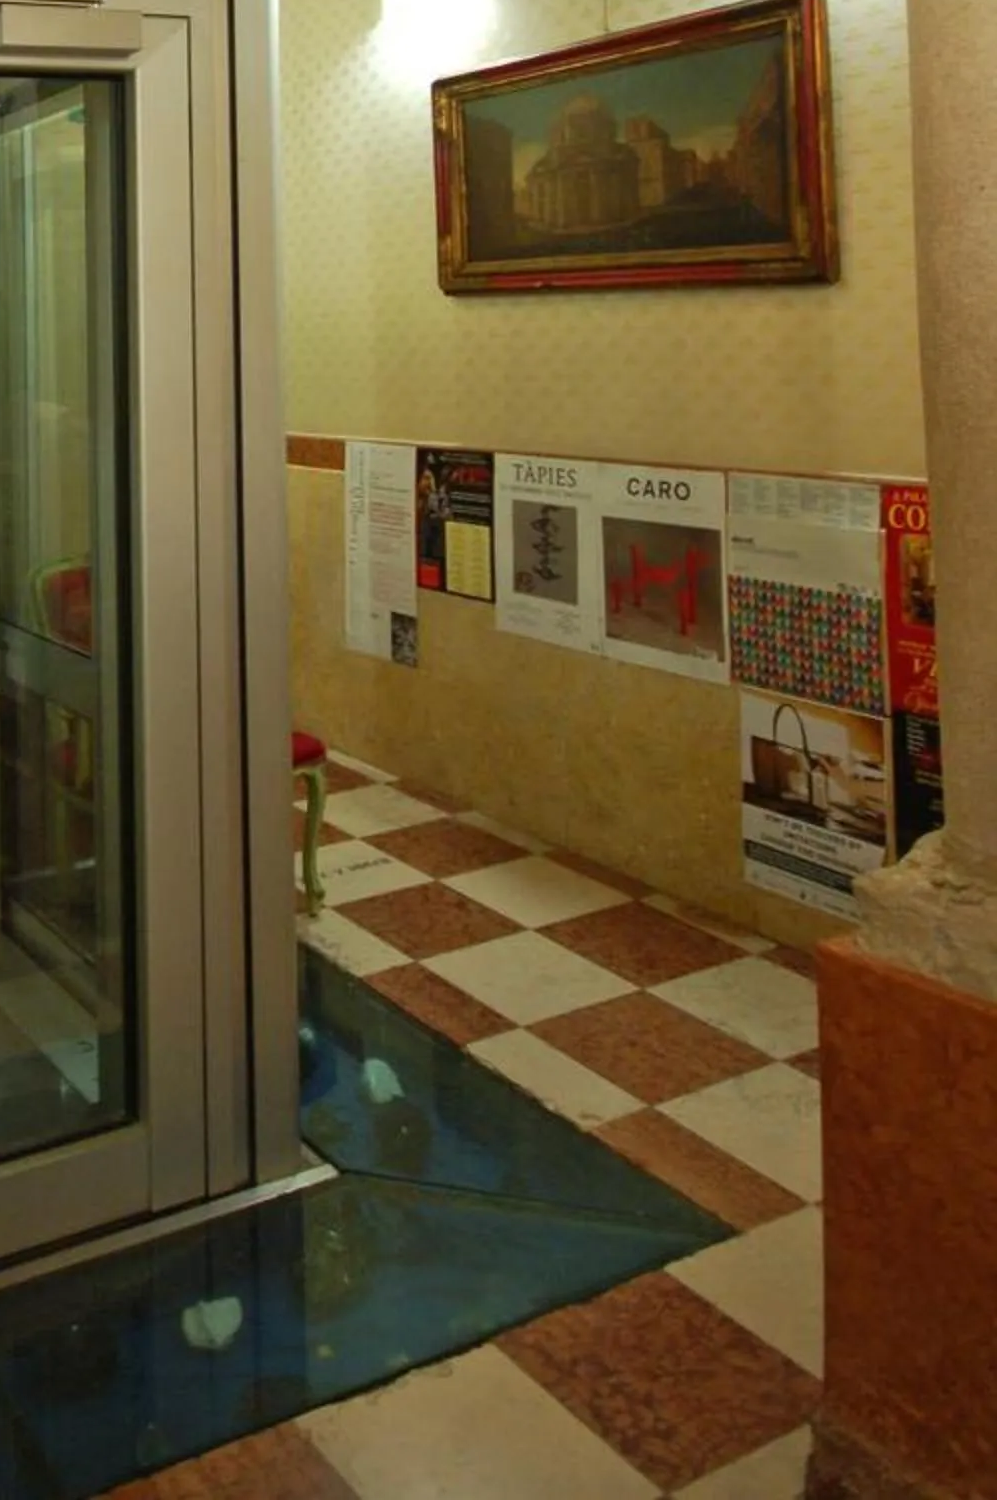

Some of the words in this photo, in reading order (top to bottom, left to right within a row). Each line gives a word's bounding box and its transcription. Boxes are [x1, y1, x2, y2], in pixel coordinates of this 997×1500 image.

[512, 460, 577, 488] TÀPIES
[626, 477, 691, 501] CARO
[888, 503, 928, 531] CO
